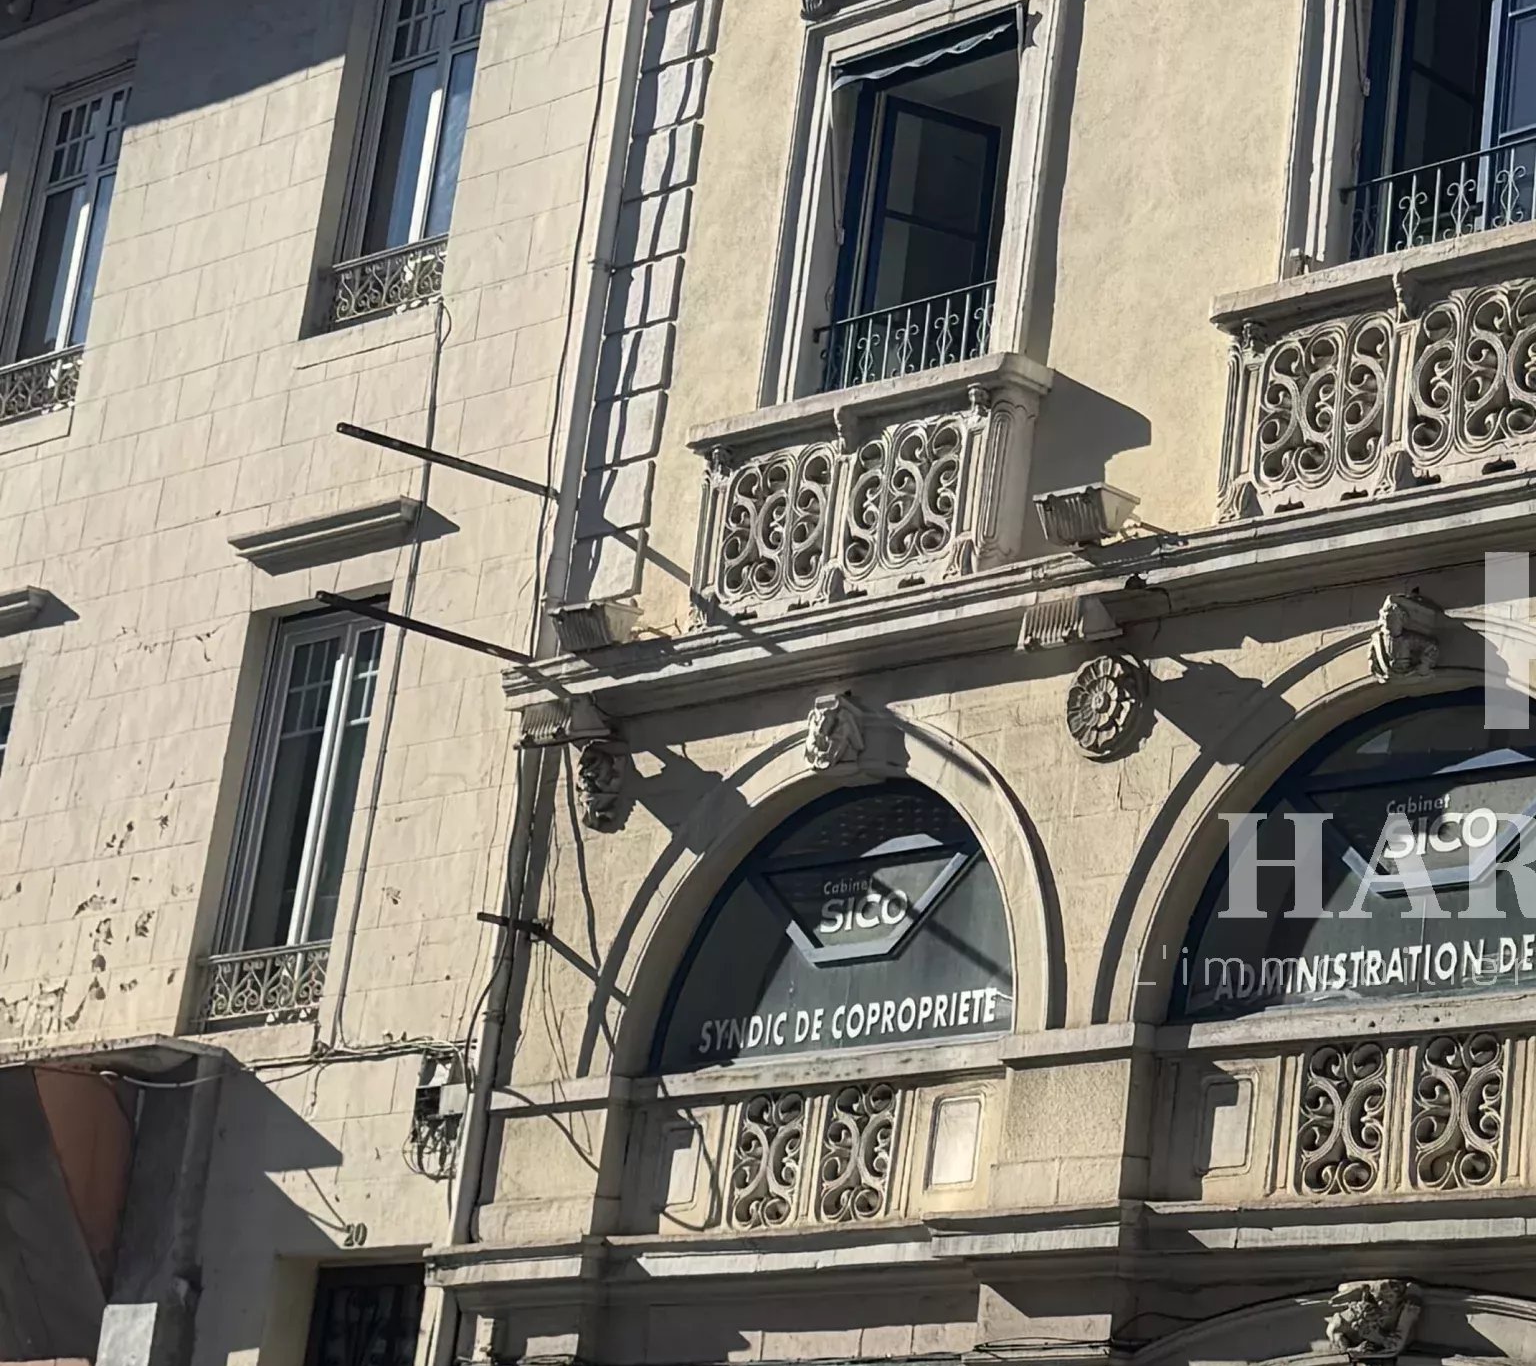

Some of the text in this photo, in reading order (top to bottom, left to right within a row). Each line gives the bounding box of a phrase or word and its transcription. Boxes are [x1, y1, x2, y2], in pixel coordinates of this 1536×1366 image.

[1386, 793, 1450, 814] Cabinet
[1383, 807, 1497, 858] SICO
[820, 889, 909, 934] SICO
[1214, 939, 1484, 1002] ADMINISTRATION
[1500, 934, 1534, 973] DE
[699, 987, 998, 1054] SYNDIC DE COPROPRIETE
[344, 1222, 368, 1247] 20
